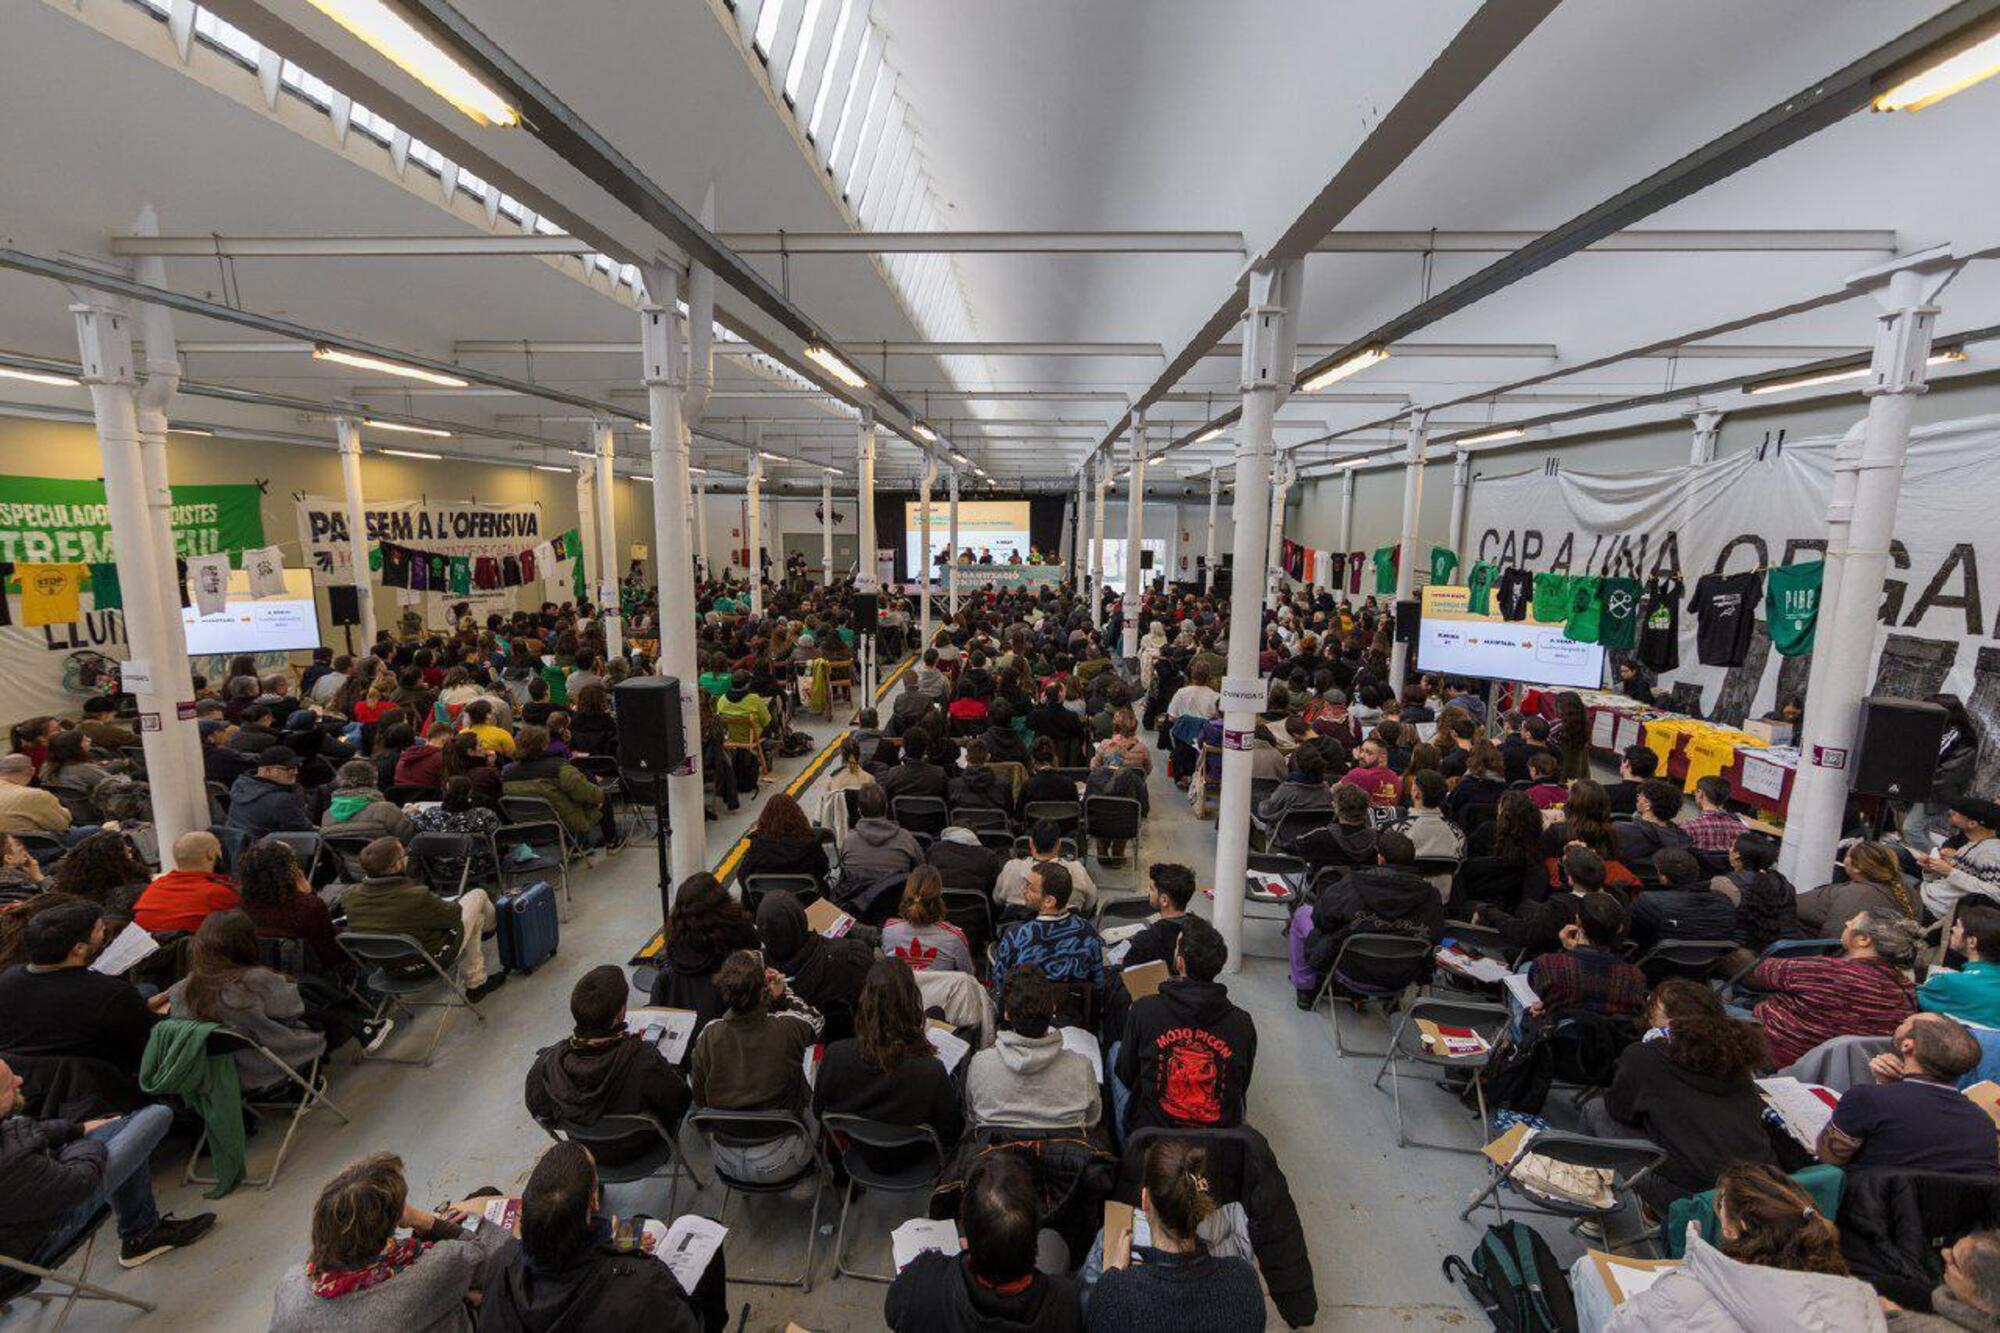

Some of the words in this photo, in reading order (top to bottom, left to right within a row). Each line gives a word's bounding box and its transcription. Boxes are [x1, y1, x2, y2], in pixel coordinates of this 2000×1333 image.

[309, 511, 414, 543] PASEM
[418, 512, 433, 540] A
[437, 511, 538, 540] L'OFENSIVA
[1480, 528, 1544, 571] CAP
[1156, 1028, 1193, 1049] MOJO
